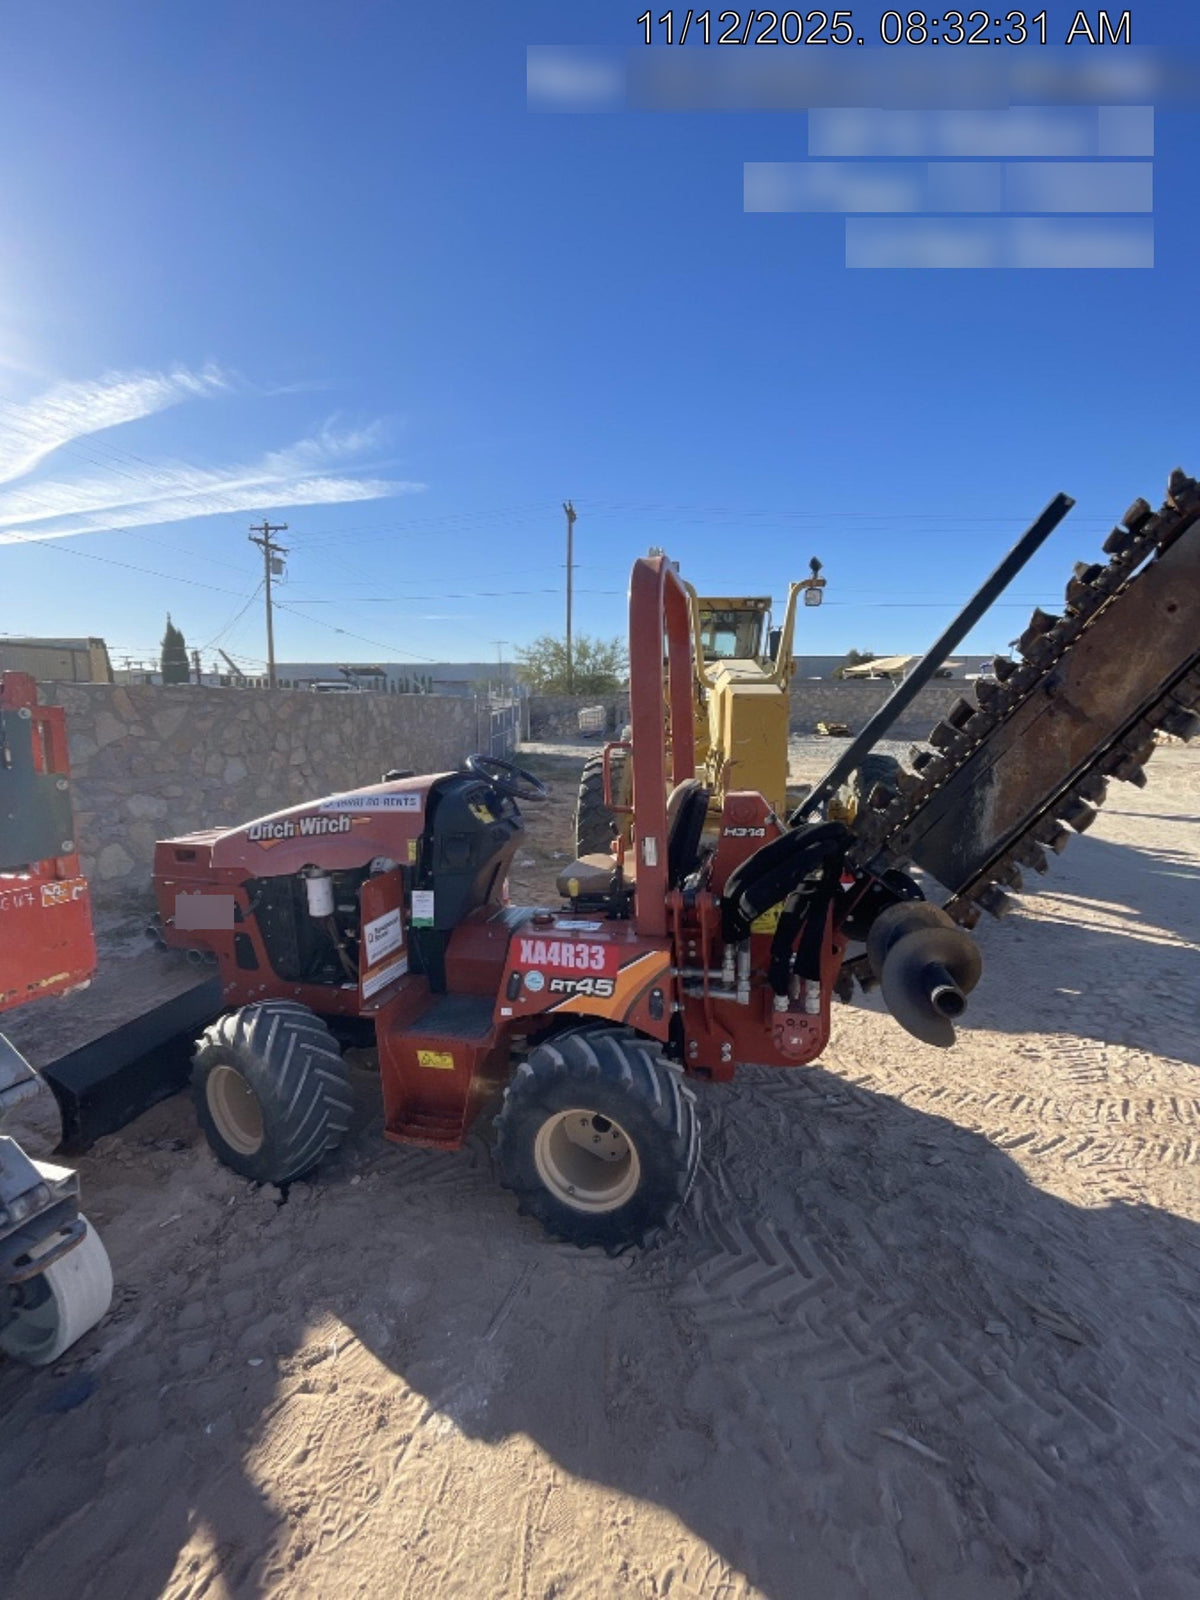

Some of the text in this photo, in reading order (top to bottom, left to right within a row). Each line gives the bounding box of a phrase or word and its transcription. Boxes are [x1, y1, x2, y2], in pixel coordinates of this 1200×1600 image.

[247, 813, 352, 840] Ditch Witch
[519, 939, 606, 971] XA4R33
[549, 977, 615, 997] RT45
